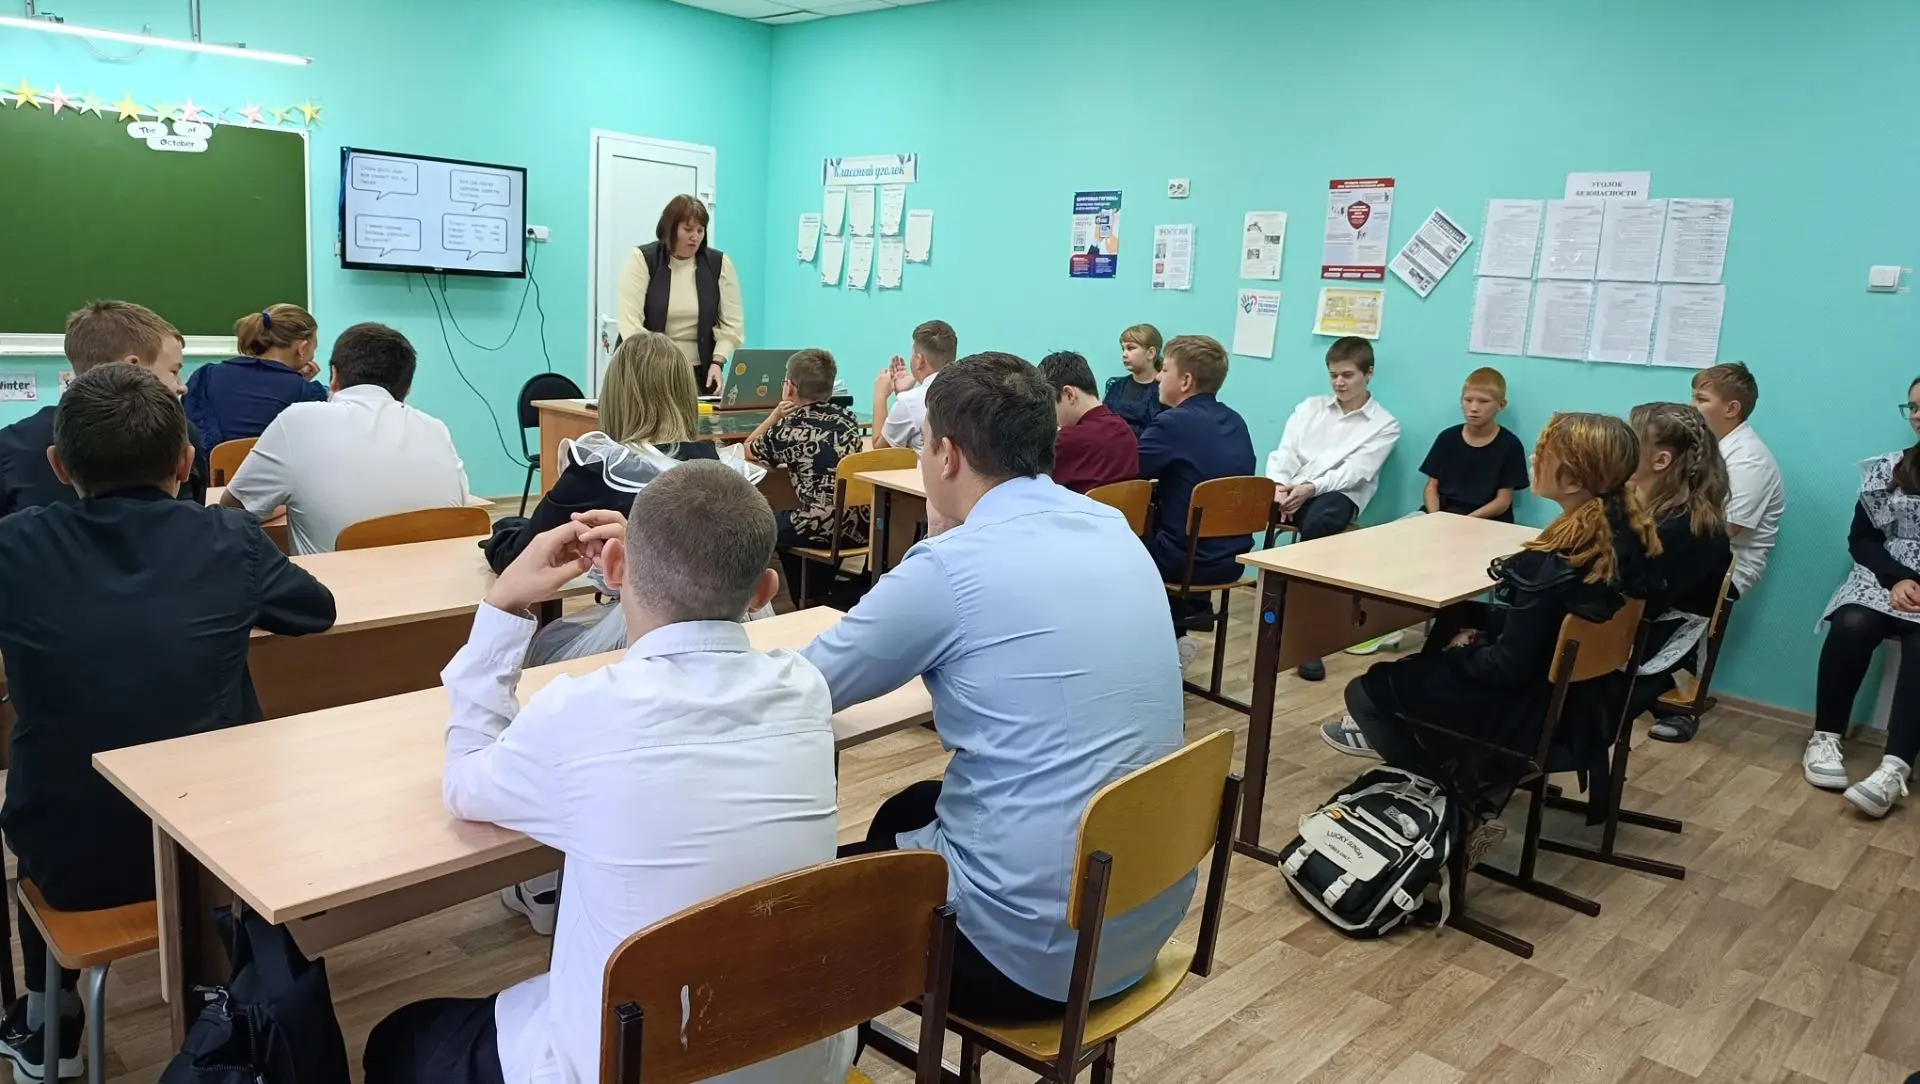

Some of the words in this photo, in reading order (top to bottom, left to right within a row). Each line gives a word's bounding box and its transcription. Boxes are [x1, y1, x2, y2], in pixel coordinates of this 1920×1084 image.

[139, 126, 157, 134] The
[159, 138, 195, 148] October
[833, 164, 874, 179] Классный
[874, 165, 906, 181] уголок
[1591, 180, 1624, 189] УГОЛОК
[1575, 190, 1637, 198] БЕЗОПАСНОСТИ
[1326, 830, 1348, 843] LUCKY
[1347, 841, 1365, 859] SUNDAY
